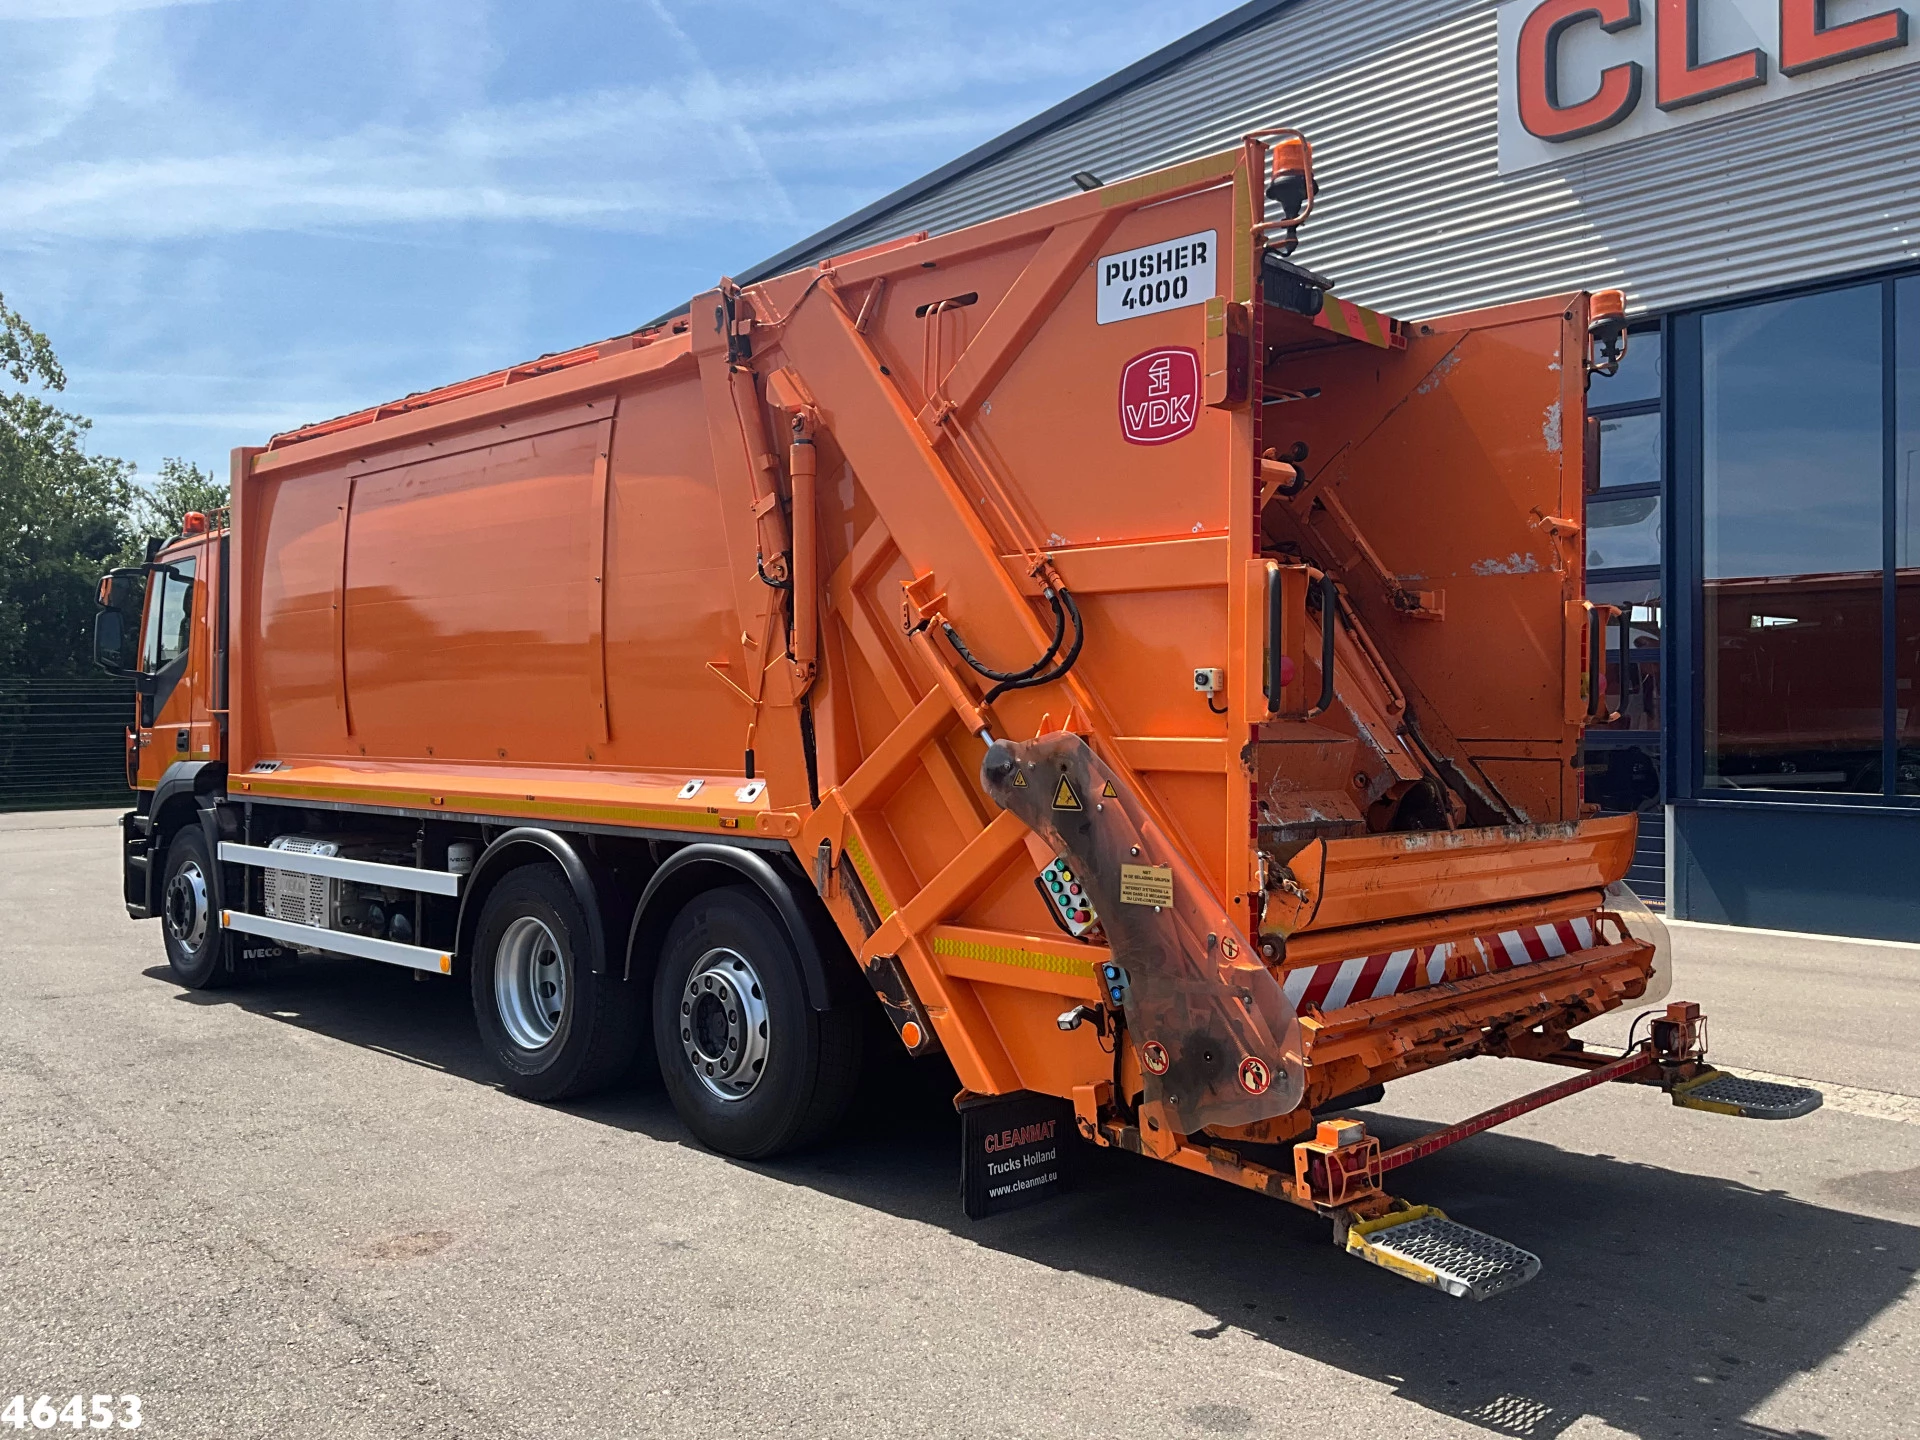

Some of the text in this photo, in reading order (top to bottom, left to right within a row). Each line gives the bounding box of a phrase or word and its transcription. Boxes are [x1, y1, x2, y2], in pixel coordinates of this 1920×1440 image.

[1106, 242, 1207, 286] PUSHER
[1121, 275, 1188, 310] 4000
[1126, 394, 1190, 431] VDK
[243, 948, 282, 959] IVECO
[984, 1120, 1056, 1153] CLEANMAT
[987, 1147, 1056, 1176] Trucks Holland
[989, 1172, 1058, 1198] www.cleanmat.eu
